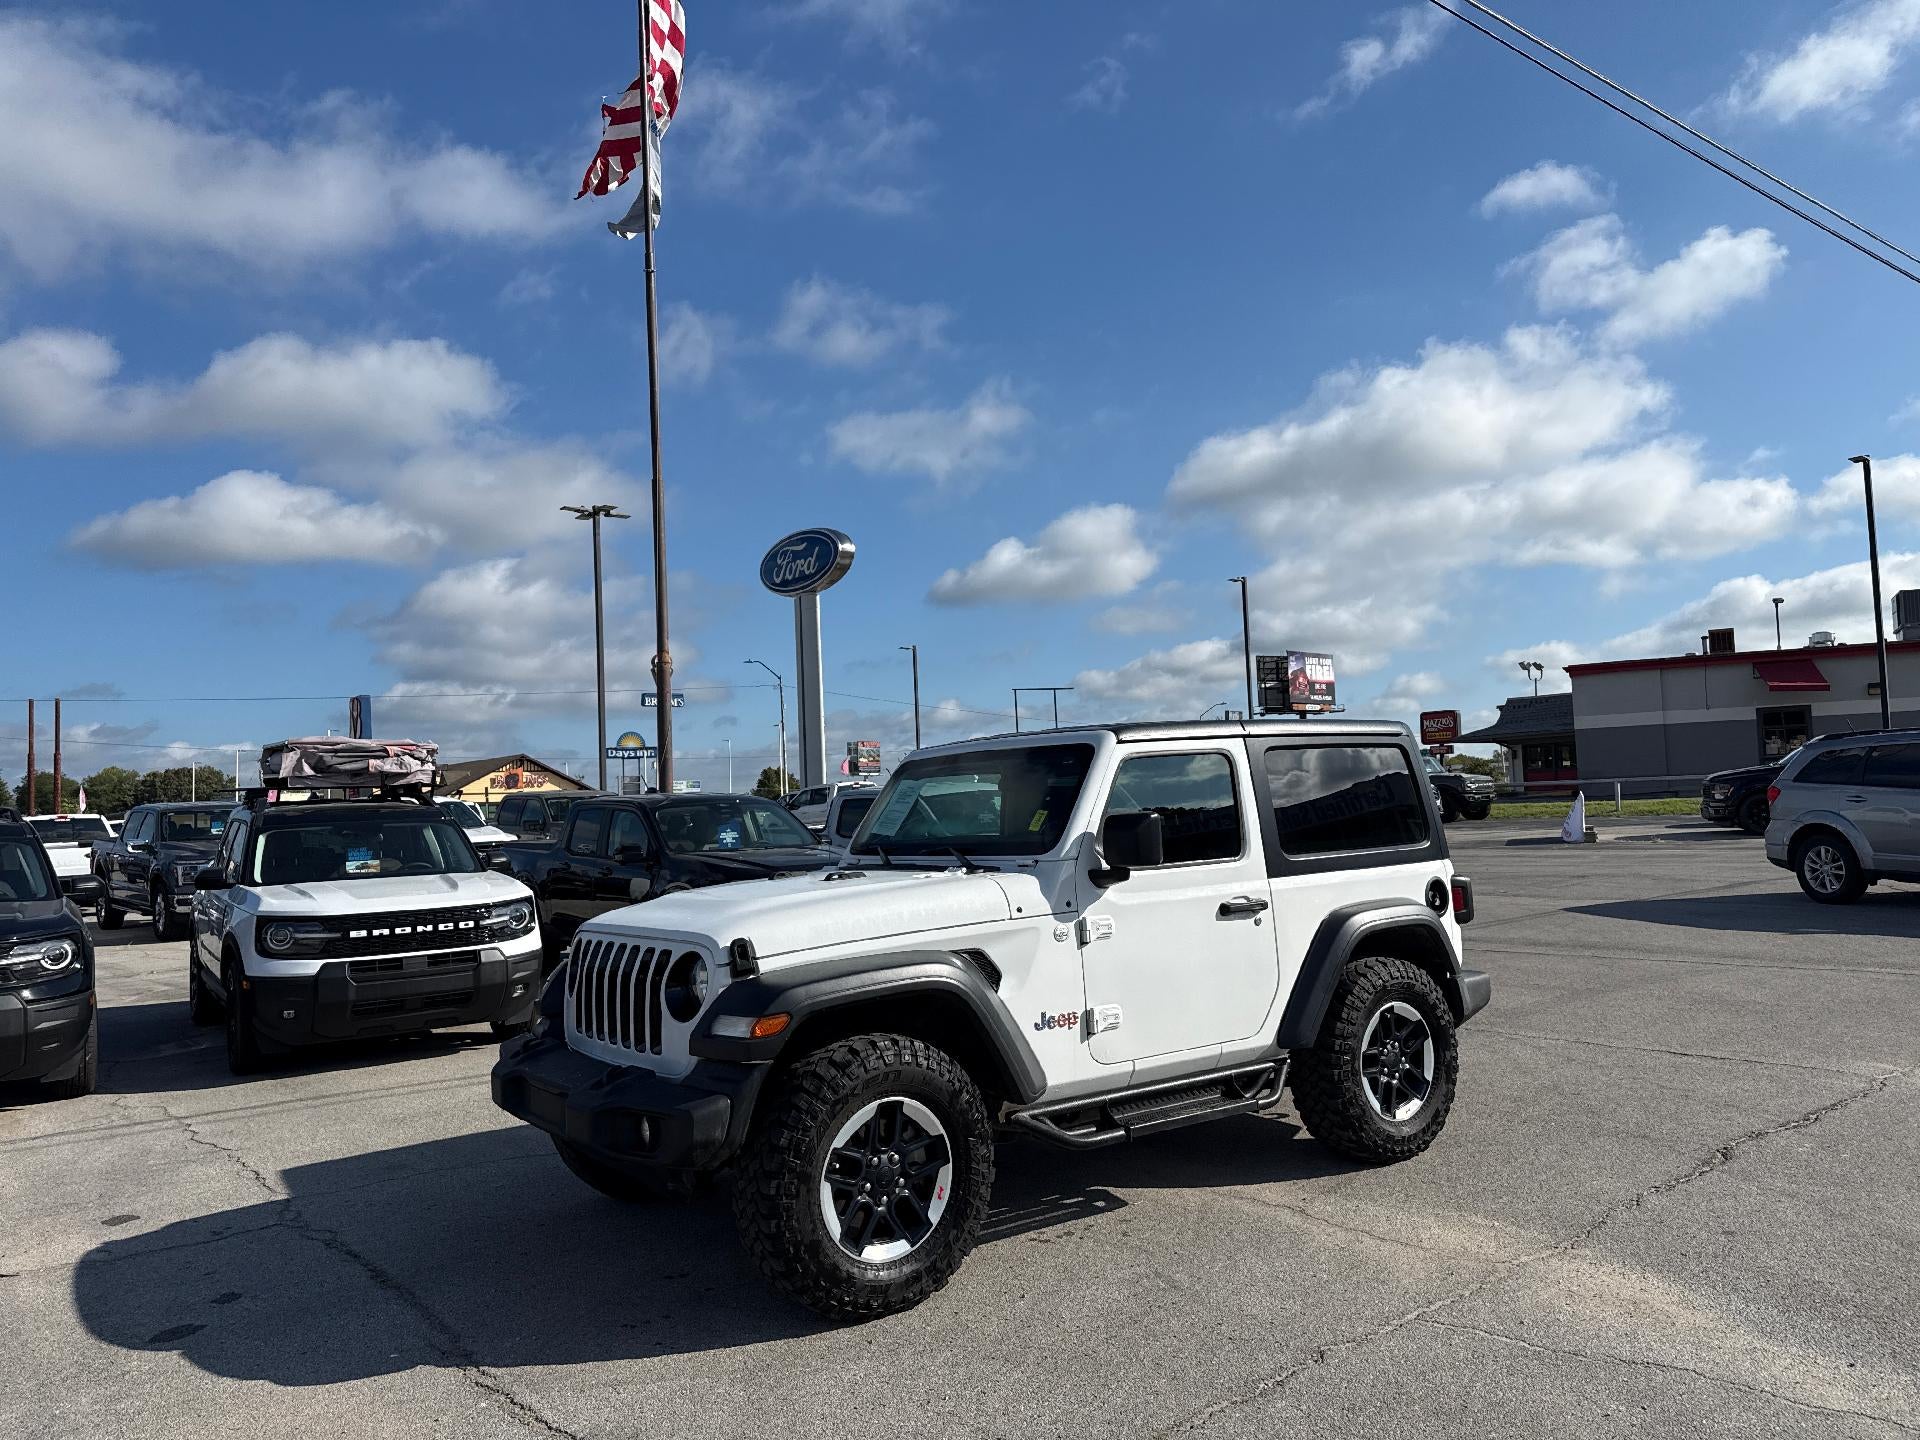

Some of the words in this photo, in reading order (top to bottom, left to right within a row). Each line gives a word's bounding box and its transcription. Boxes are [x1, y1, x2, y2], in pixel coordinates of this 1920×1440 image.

[773, 542, 819, 583] Ford
[645, 697, 684, 707] BRM'S
[1424, 716, 1454, 730] MAZZIO'S
[608, 749, 636, 758] Days
[349, 920, 475, 938] BRONCO
[1034, 1011, 1079, 1031] Jeep
